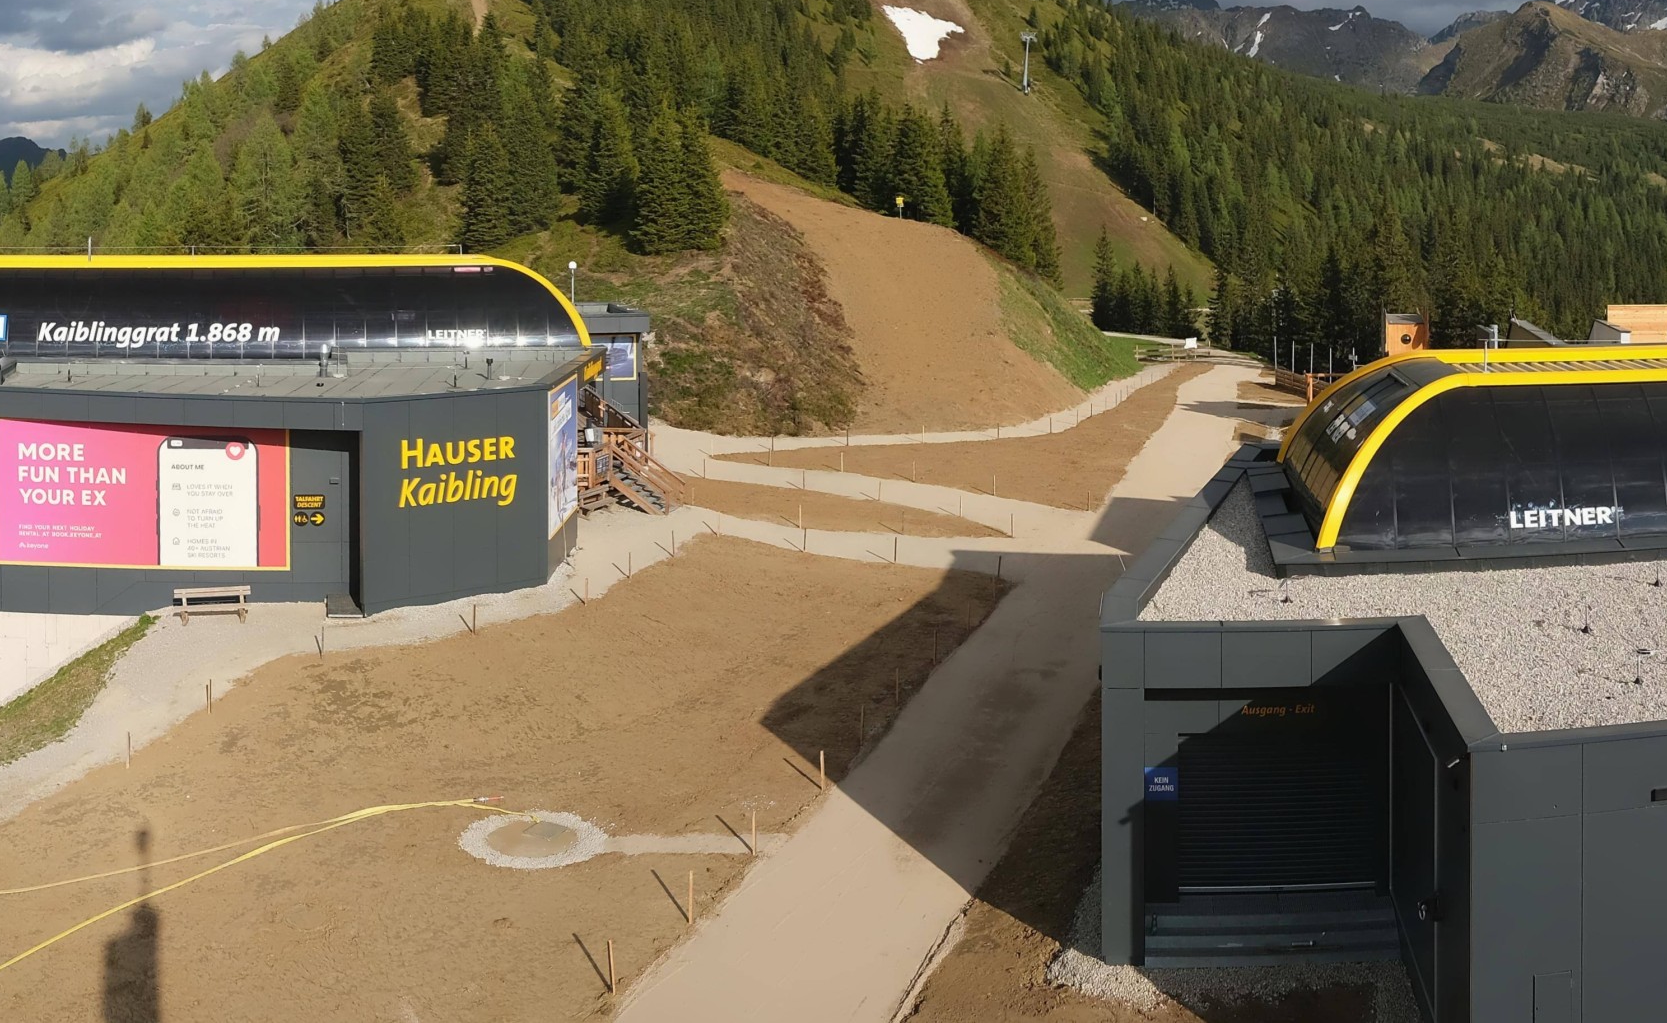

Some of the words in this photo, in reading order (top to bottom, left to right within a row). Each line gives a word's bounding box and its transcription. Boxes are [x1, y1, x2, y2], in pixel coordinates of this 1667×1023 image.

[37, 321, 181, 348] Kaiblinggrat
[185, 322, 252, 342] 1.868
[257, 326, 281, 342] m
[428, 329, 485, 339] LEITNER
[17, 443, 85, 461] MORE
[401, 436, 516, 470] HAUSER
[18, 466, 59, 483] FUN
[66, 467, 126, 484] THAN
[19, 488, 76, 505] YOUR
[81, 490, 106, 506] EX
[398, 470, 518, 508] Kaibling
[1509, 506, 1614, 529] LEITNER
[1241, 705, 1286, 717] Ausgang
[1295, 704, 1316, 714] Exit
[1148, 784, 1174, 792] ZUGANG
[1154, 776, 1169, 784] KEIN
